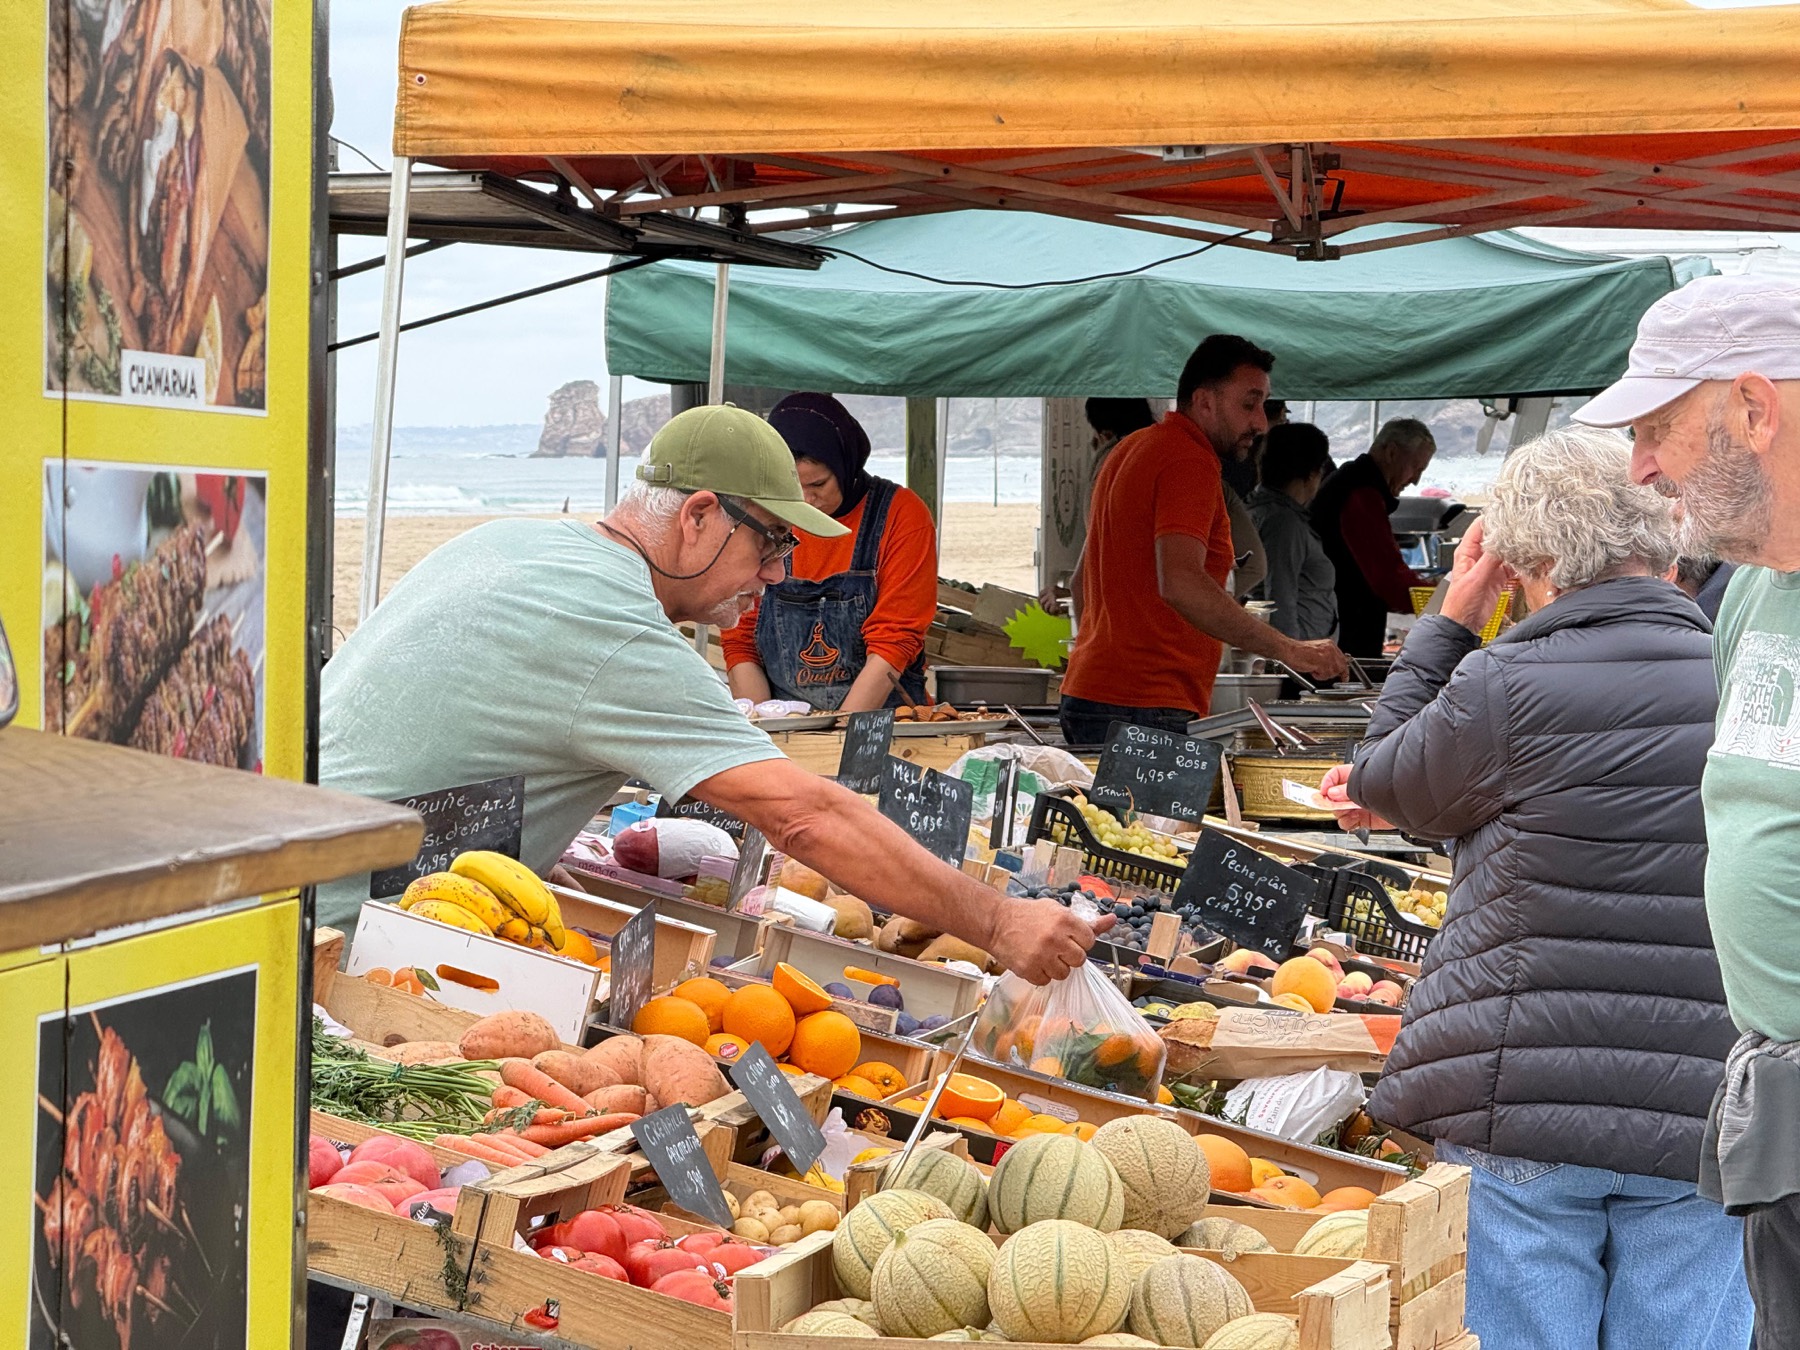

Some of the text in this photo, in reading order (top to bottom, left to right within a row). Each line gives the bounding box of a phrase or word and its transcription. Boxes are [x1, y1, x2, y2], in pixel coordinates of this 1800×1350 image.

[129, 364, 198, 399] CHAWARMA
[1756, 663, 1779, 684] THE
[1741, 702, 1768, 725] FACE
[577, 860, 618, 879] mango
